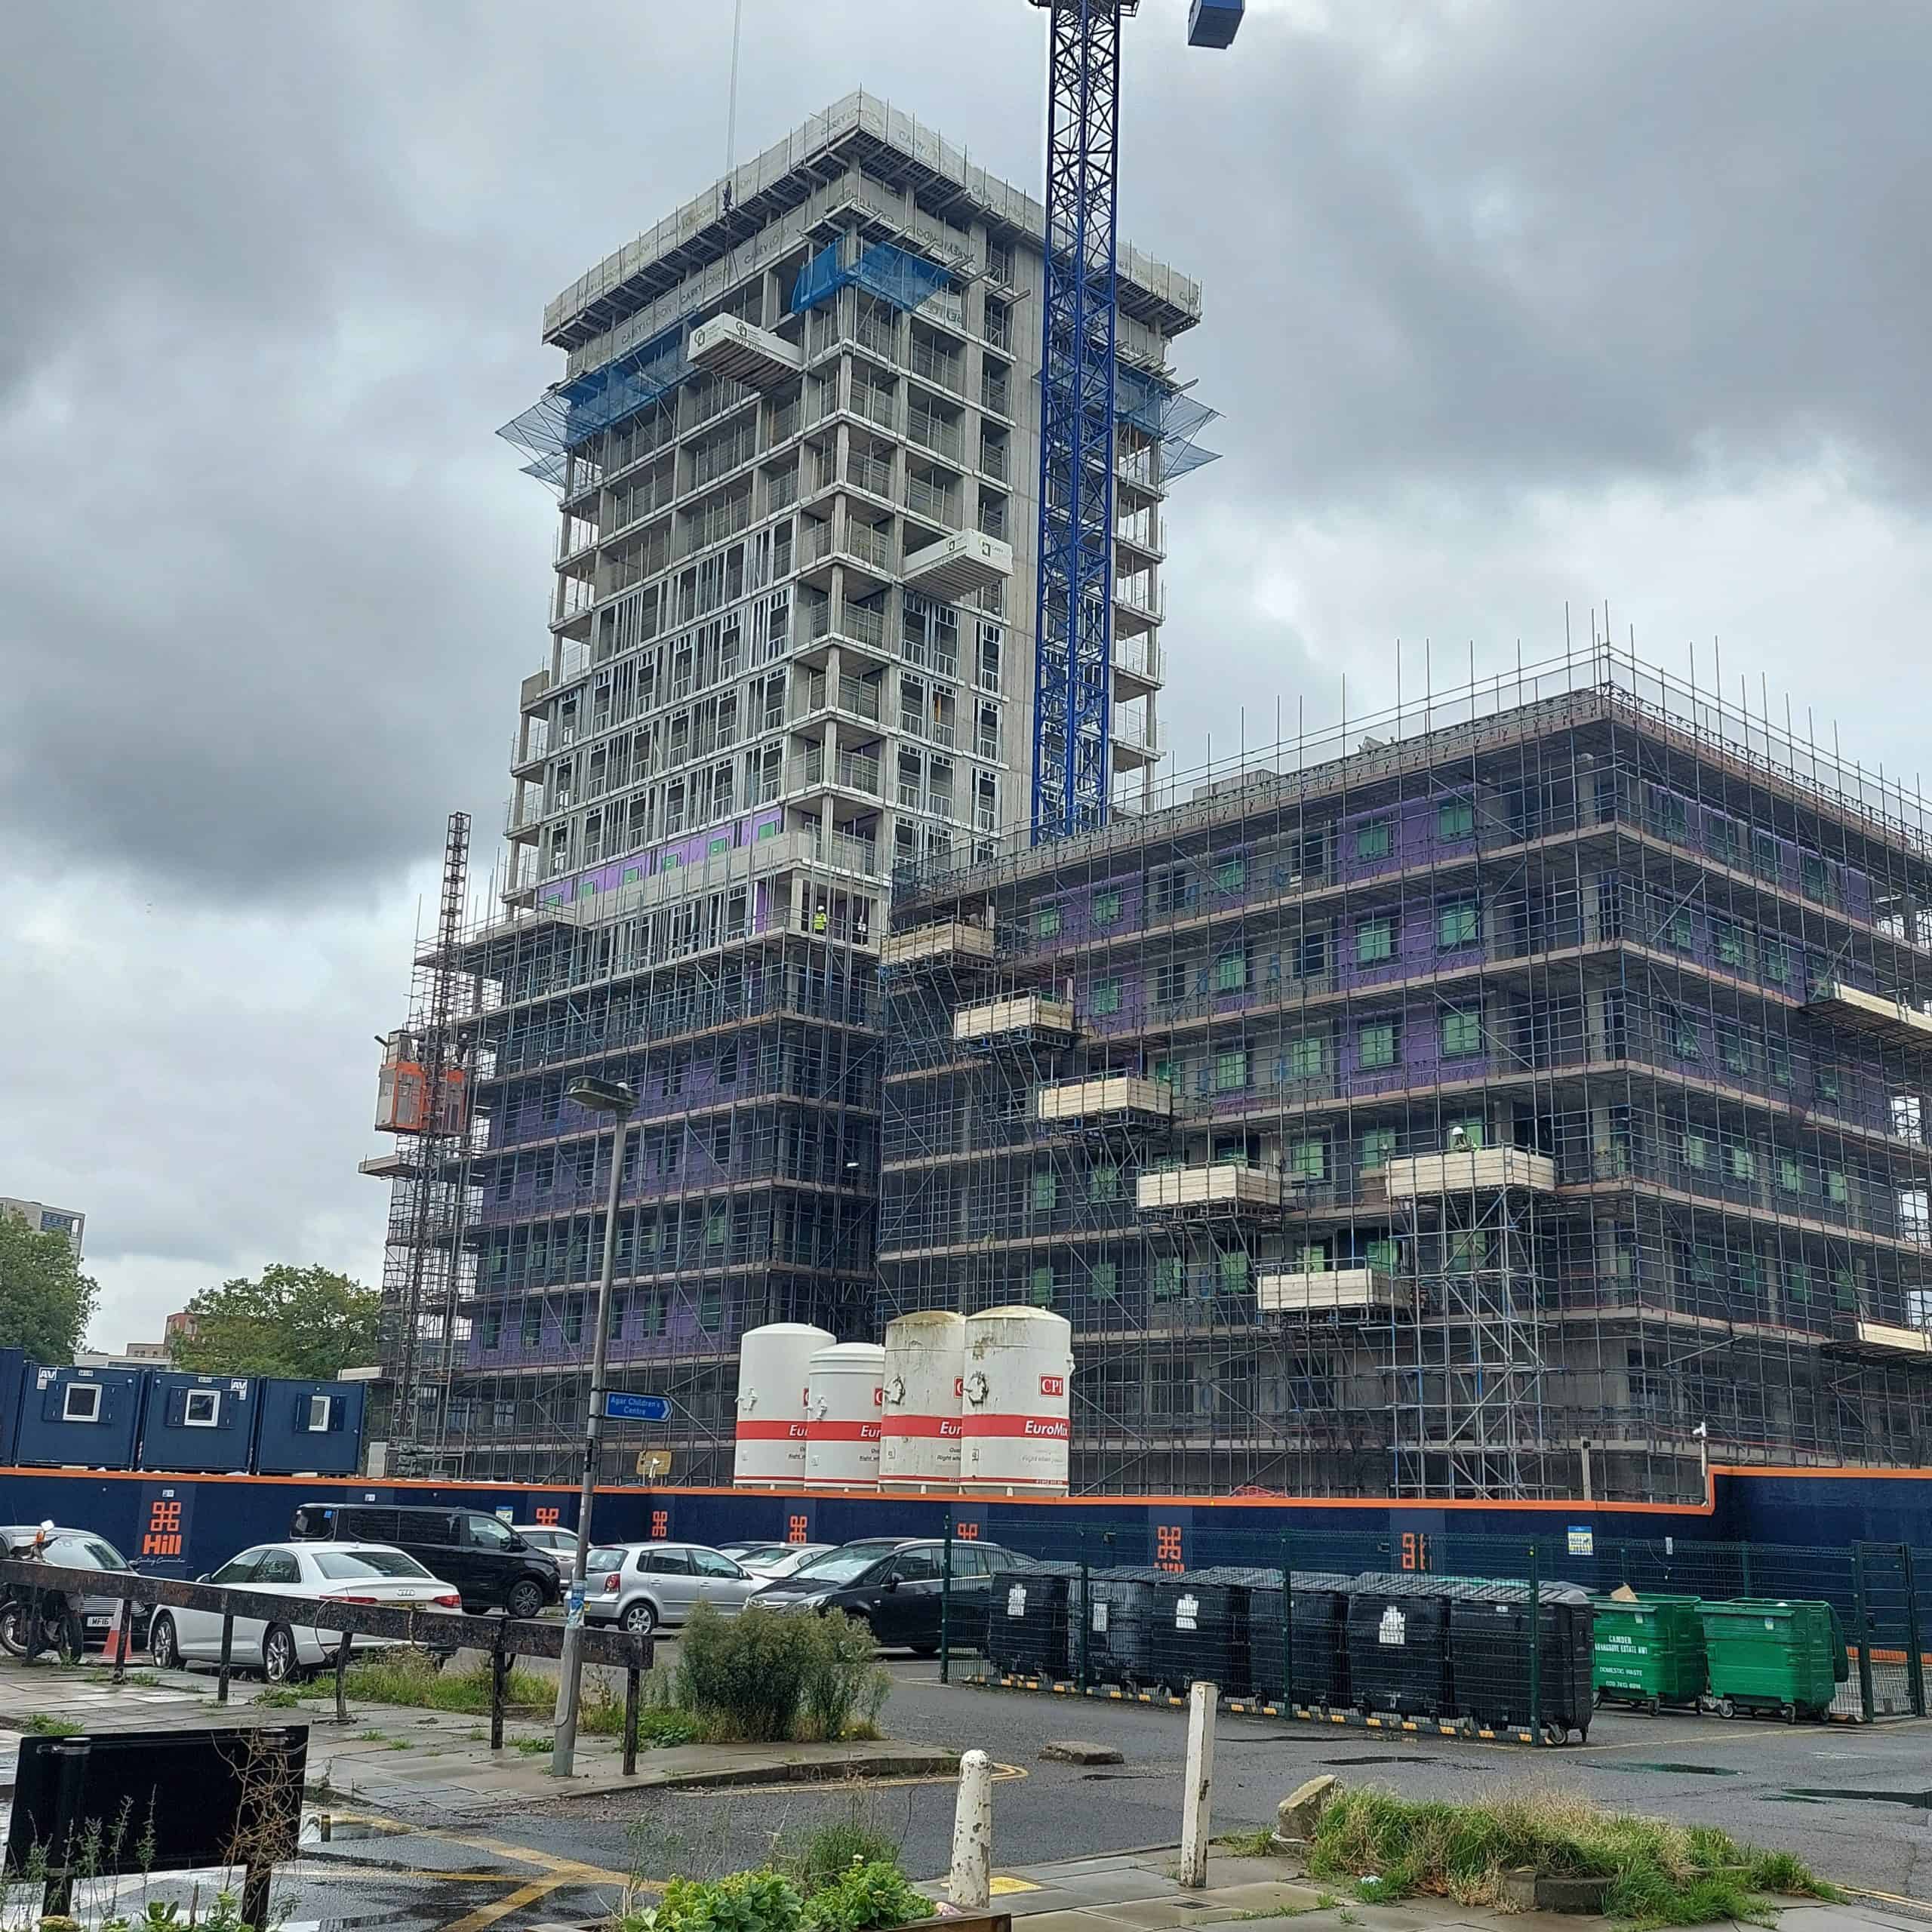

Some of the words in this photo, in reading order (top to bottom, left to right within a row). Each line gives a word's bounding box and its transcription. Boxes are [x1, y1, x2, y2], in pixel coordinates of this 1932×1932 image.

[1041, 1378, 1063, 1394] CPI
[623, 1406, 646, 1416] Centre
[1025, 1420, 1068, 1437] EuroMix
[143, 1534, 181, 1555] Hill
